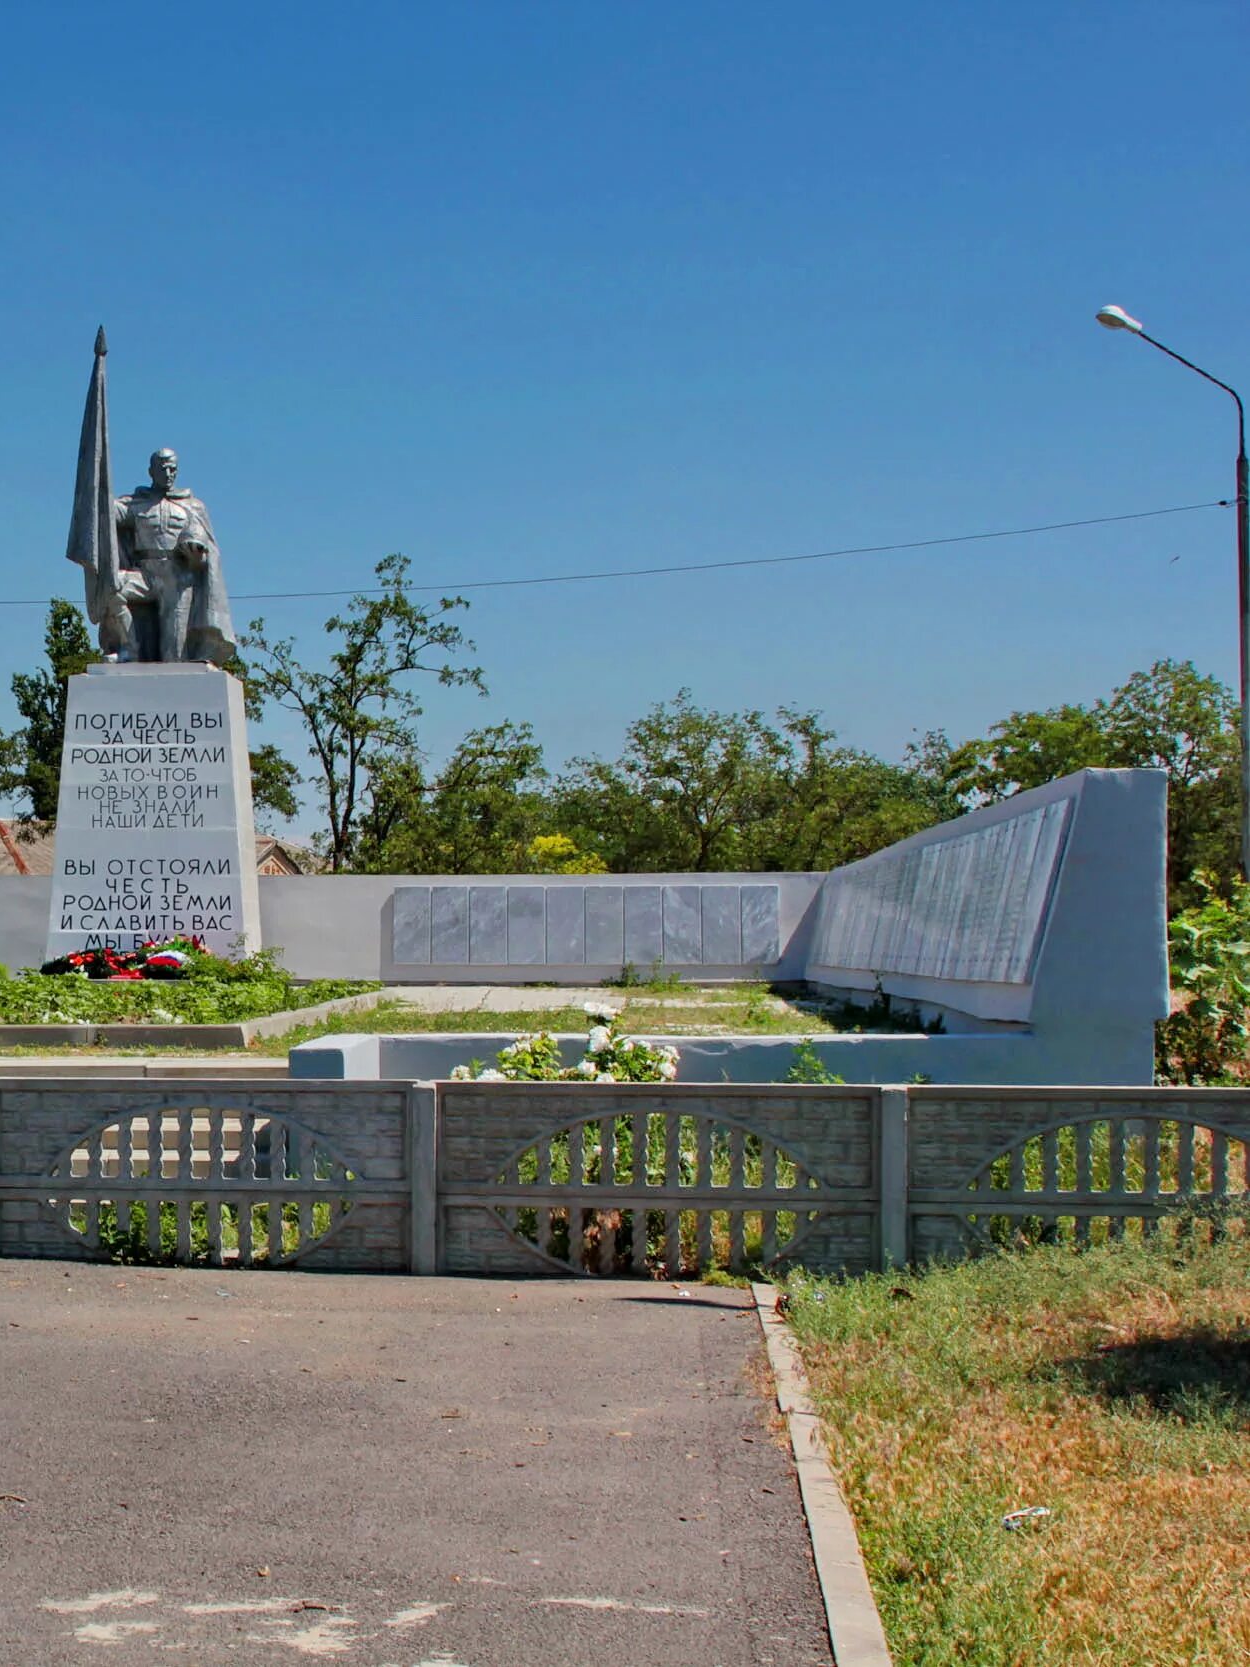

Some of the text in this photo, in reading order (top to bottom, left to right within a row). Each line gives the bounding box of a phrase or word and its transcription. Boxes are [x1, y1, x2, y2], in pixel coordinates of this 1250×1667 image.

[75, 712, 223, 729] ПОГИБЛИ ВЫ
[102, 729, 196, 744] ЗА ЧЕСТЬ
[71, 746, 225, 764] РОДНОЙ ЗЕМЛИ
[100, 769, 119, 782] ЗА
[78, 786, 149, 800] НОВЫХ
[100, 800, 196, 814] НЕ ЗНАЛИ
[92, 813, 204, 828] НАШИ ДЕТИ
[64, 859, 231, 875] ВЫ ОТСТОЯЛИ
[106, 878, 189, 894] ЧЕСТЬ
[63, 895, 231, 910] РОДНОЙ ЗЕМЛИ
[61, 915, 232, 930] И СЛАВИТЬ ВАС
[85, 934, 121, 950] МЫ
